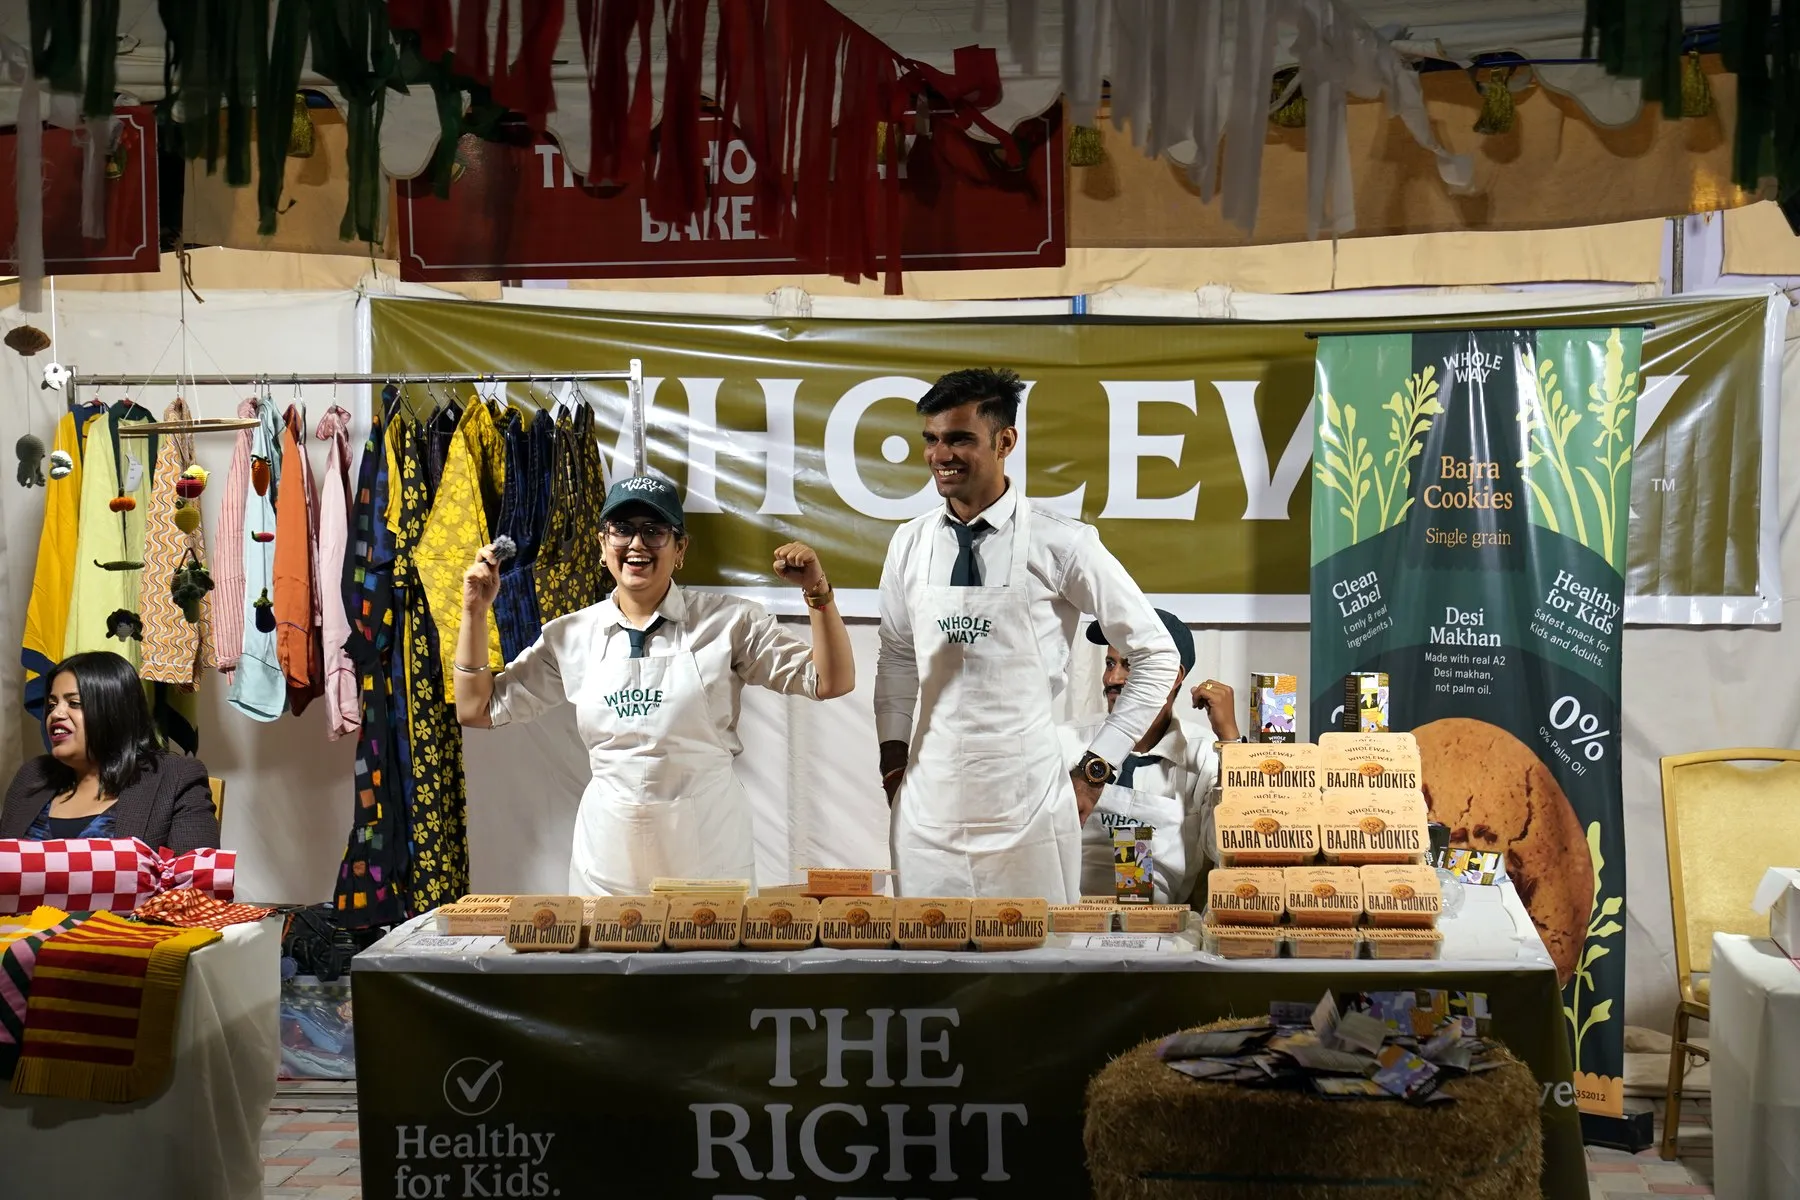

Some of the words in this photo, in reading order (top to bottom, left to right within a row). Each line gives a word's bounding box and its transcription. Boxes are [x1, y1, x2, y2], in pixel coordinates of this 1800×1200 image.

[639, 196, 772, 242] BAKE
[1443, 352, 1503, 370] WHOLE
[1455, 368, 1491, 383] WAY
[1440, 455, 1500, 484] Bajra
[621, 477, 666, 492] WHOLE
[628, 483, 657, 492] WAY
[1651, 478, 1676, 492] TM
[1424, 485, 1513, 510] Cookies
[1426, 527, 1467, 547] Single
[1472, 529, 1511, 548] grain
[1332, 571, 1378, 600] Clean
[1553, 569, 1621, 619] Healthy
[1338, 584, 1381, 618] Label
[1367, 613, 1372, 622] 8
[1374, 604, 1388, 618] real
[1445, 607, 1484, 626] Desi
[1545, 588, 1575, 613] for
[1575, 602, 1614, 635] Kids
[937, 616, 992, 632] WHOLE
[1534, 608, 1566, 630] Safest
[1566, 626, 1595, 645] snack
[1597, 640, 1611, 653] for
[947, 630, 980, 644] WAY
[1429, 626, 1501, 647] Makhan
[1529, 622, 1549, 639] Kids
[1550, 635, 1571, 649] and
[1571, 644, 1604, 667] Adults.
[1425, 652, 1448, 662] Made
[1450, 654, 1470, 663] with
[1472, 656, 1490, 665] real
[1493, 656, 1506, 665] A2
[1434, 667, 1452, 678] Desi
[1455, 669, 1494, 681] makhan,
[604, 689, 663, 707] WHOLE
[1435, 683, 1450, 692] not
[1453, 684, 1474, 695] palm
[1477, 685, 1491, 695] oil.
[616, 703, 652, 718] WAY
[1549, 695, 1610, 761] 0%
[1550, 740, 1571, 764] Palm
[1571, 761, 1587, 777] Oil
[1269, 771, 1315, 787] COOKIES
[1327, 772, 1364, 788] BAJRA
[1369, 772, 1416, 788] COOKIES
[1101, 813, 1157, 831] WHO
[1222, 830, 1261, 848] BAJRA
[1265, 830, 1314, 848] COOKIES
[1327, 830, 1366, 849] BAJRA
[1371, 830, 1419, 849] COOKIES
[1212, 894, 1240, 909] BAJRA
[1244, 894, 1280, 911] COOKIES
[1290, 893, 1318, 908] BAJRA
[1322, 894, 1358, 909] COOKIES
[1369, 895, 1398, 910] BAJRA
[1401, 896, 1438, 911] COOKIES
[509, 924, 536, 943] BAJRA
[540, 925, 576, 944] COOKIES
[595, 924, 621, 941] BAJRA
[625, 924, 661, 942] COOKIES
[669, 921, 696, 939] BAJRA
[700, 922, 736, 940] COOKIES
[745, 922, 772, 940] BAJRA
[776, 923, 812, 940] COOKIES
[824, 922, 850, 939] BAJRA
[855, 922, 891, 940] COOKIES
[899, 922, 927, 939] BAJRA
[930, 922, 966, 939] COOKIES
[975, 920, 1003, 937] BAJRA
[1007, 921, 1043, 938] COOKIES
[750, 1007, 964, 1088] THE
[396, 1123, 555, 1165] Healthy
[688, 1102, 1029, 1183] RIGHT
[395, 1165, 451, 1199] for
[462, 1163, 561, 1198] Kids.
